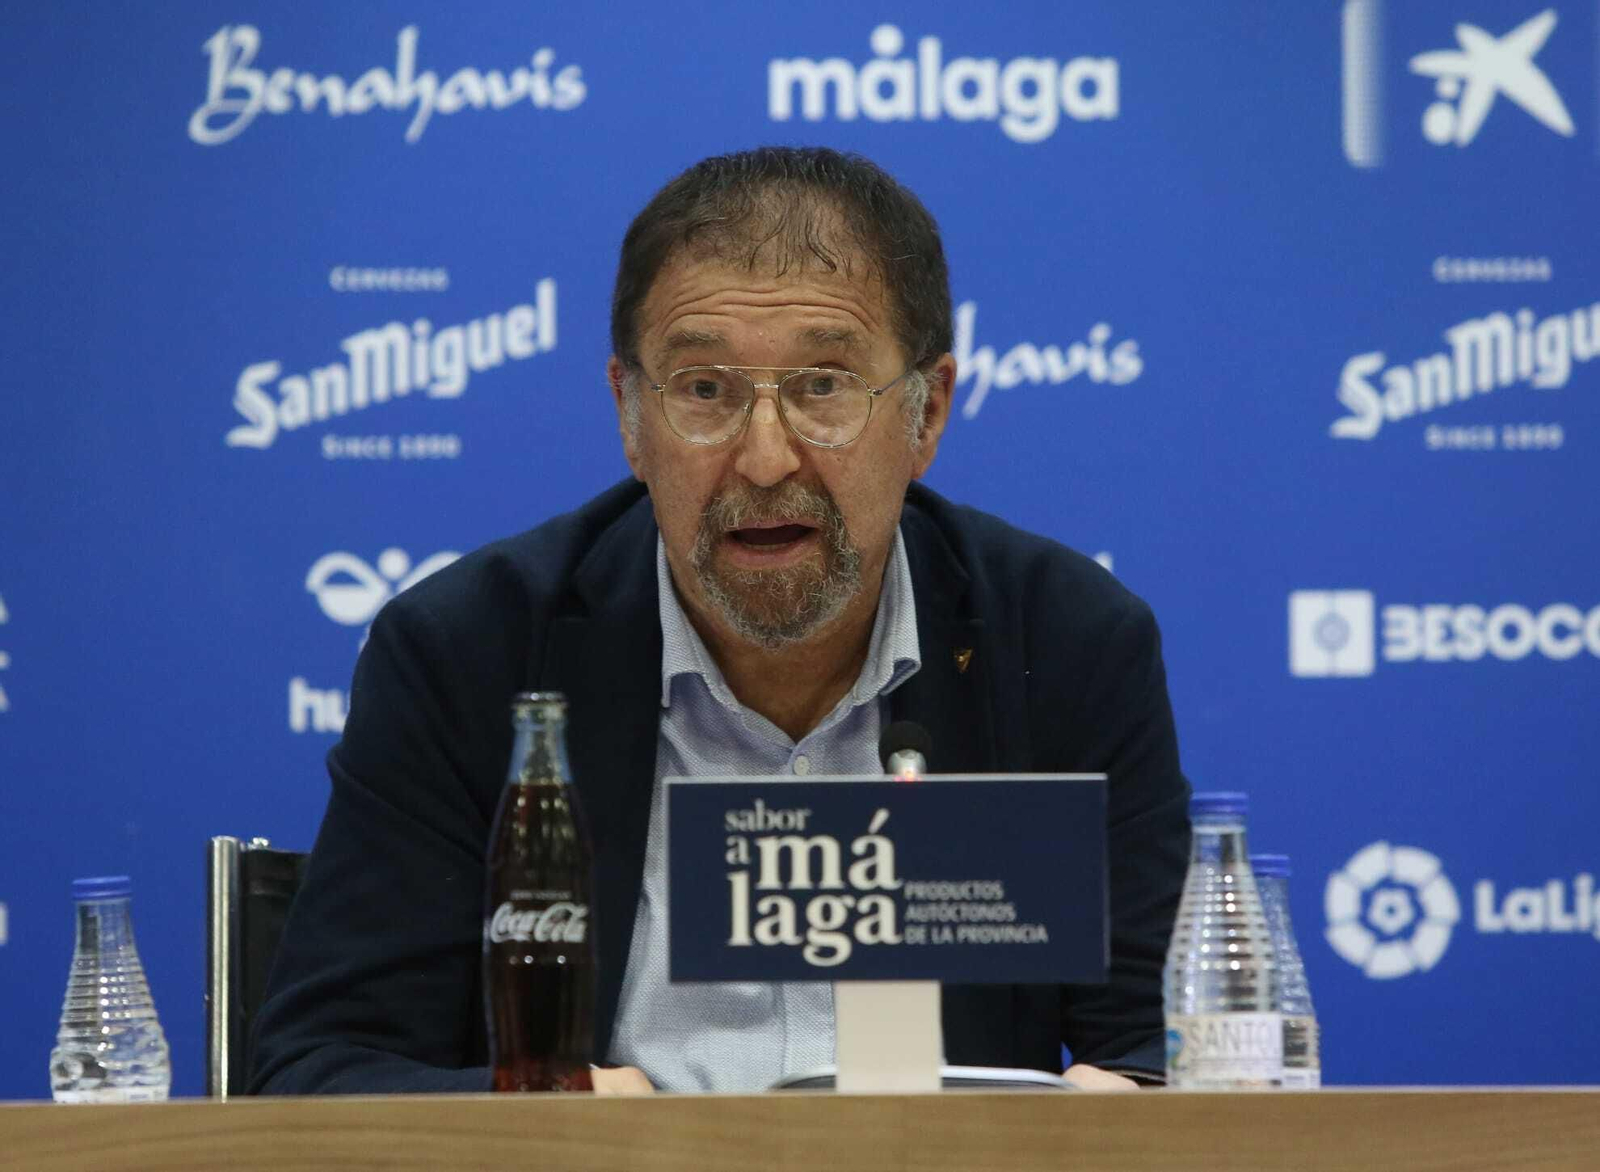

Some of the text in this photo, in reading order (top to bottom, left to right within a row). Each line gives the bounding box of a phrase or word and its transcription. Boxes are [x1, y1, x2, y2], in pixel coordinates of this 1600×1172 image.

[955, 301, 1143, 419] havis
[1383, 603, 1600, 661] BESOC
[725, 799, 811, 831] sabor
[726, 808, 903, 891] a má
[727, 870, 903, 968] laga
[904, 881, 1004, 900] PRODUCTOS
[904, 923, 1049, 945] DE LA PROVINCIA
